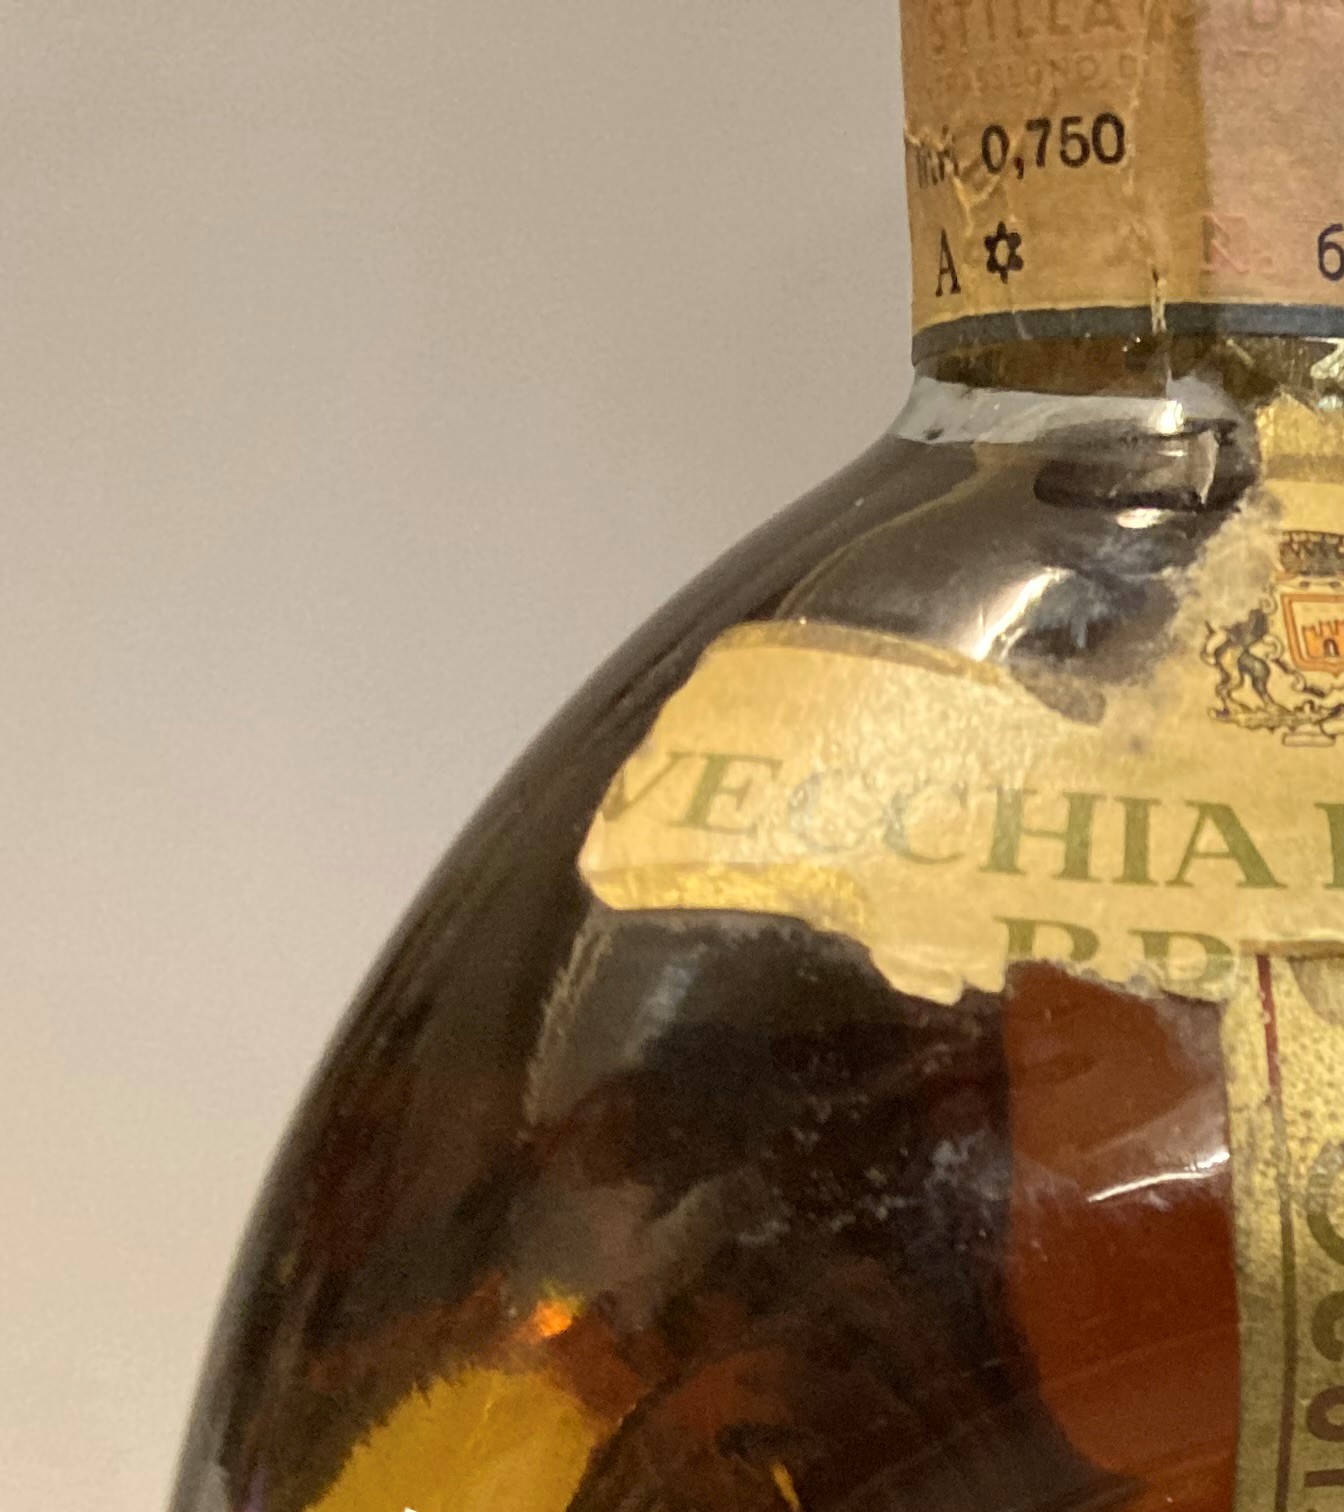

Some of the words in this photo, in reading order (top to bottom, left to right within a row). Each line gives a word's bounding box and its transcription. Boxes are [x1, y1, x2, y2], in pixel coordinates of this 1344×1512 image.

[981, 112, 1126, 180] 0,750
[934, 227, 962, 297] A
[600, 751, 1289, 889] VECCHIA
